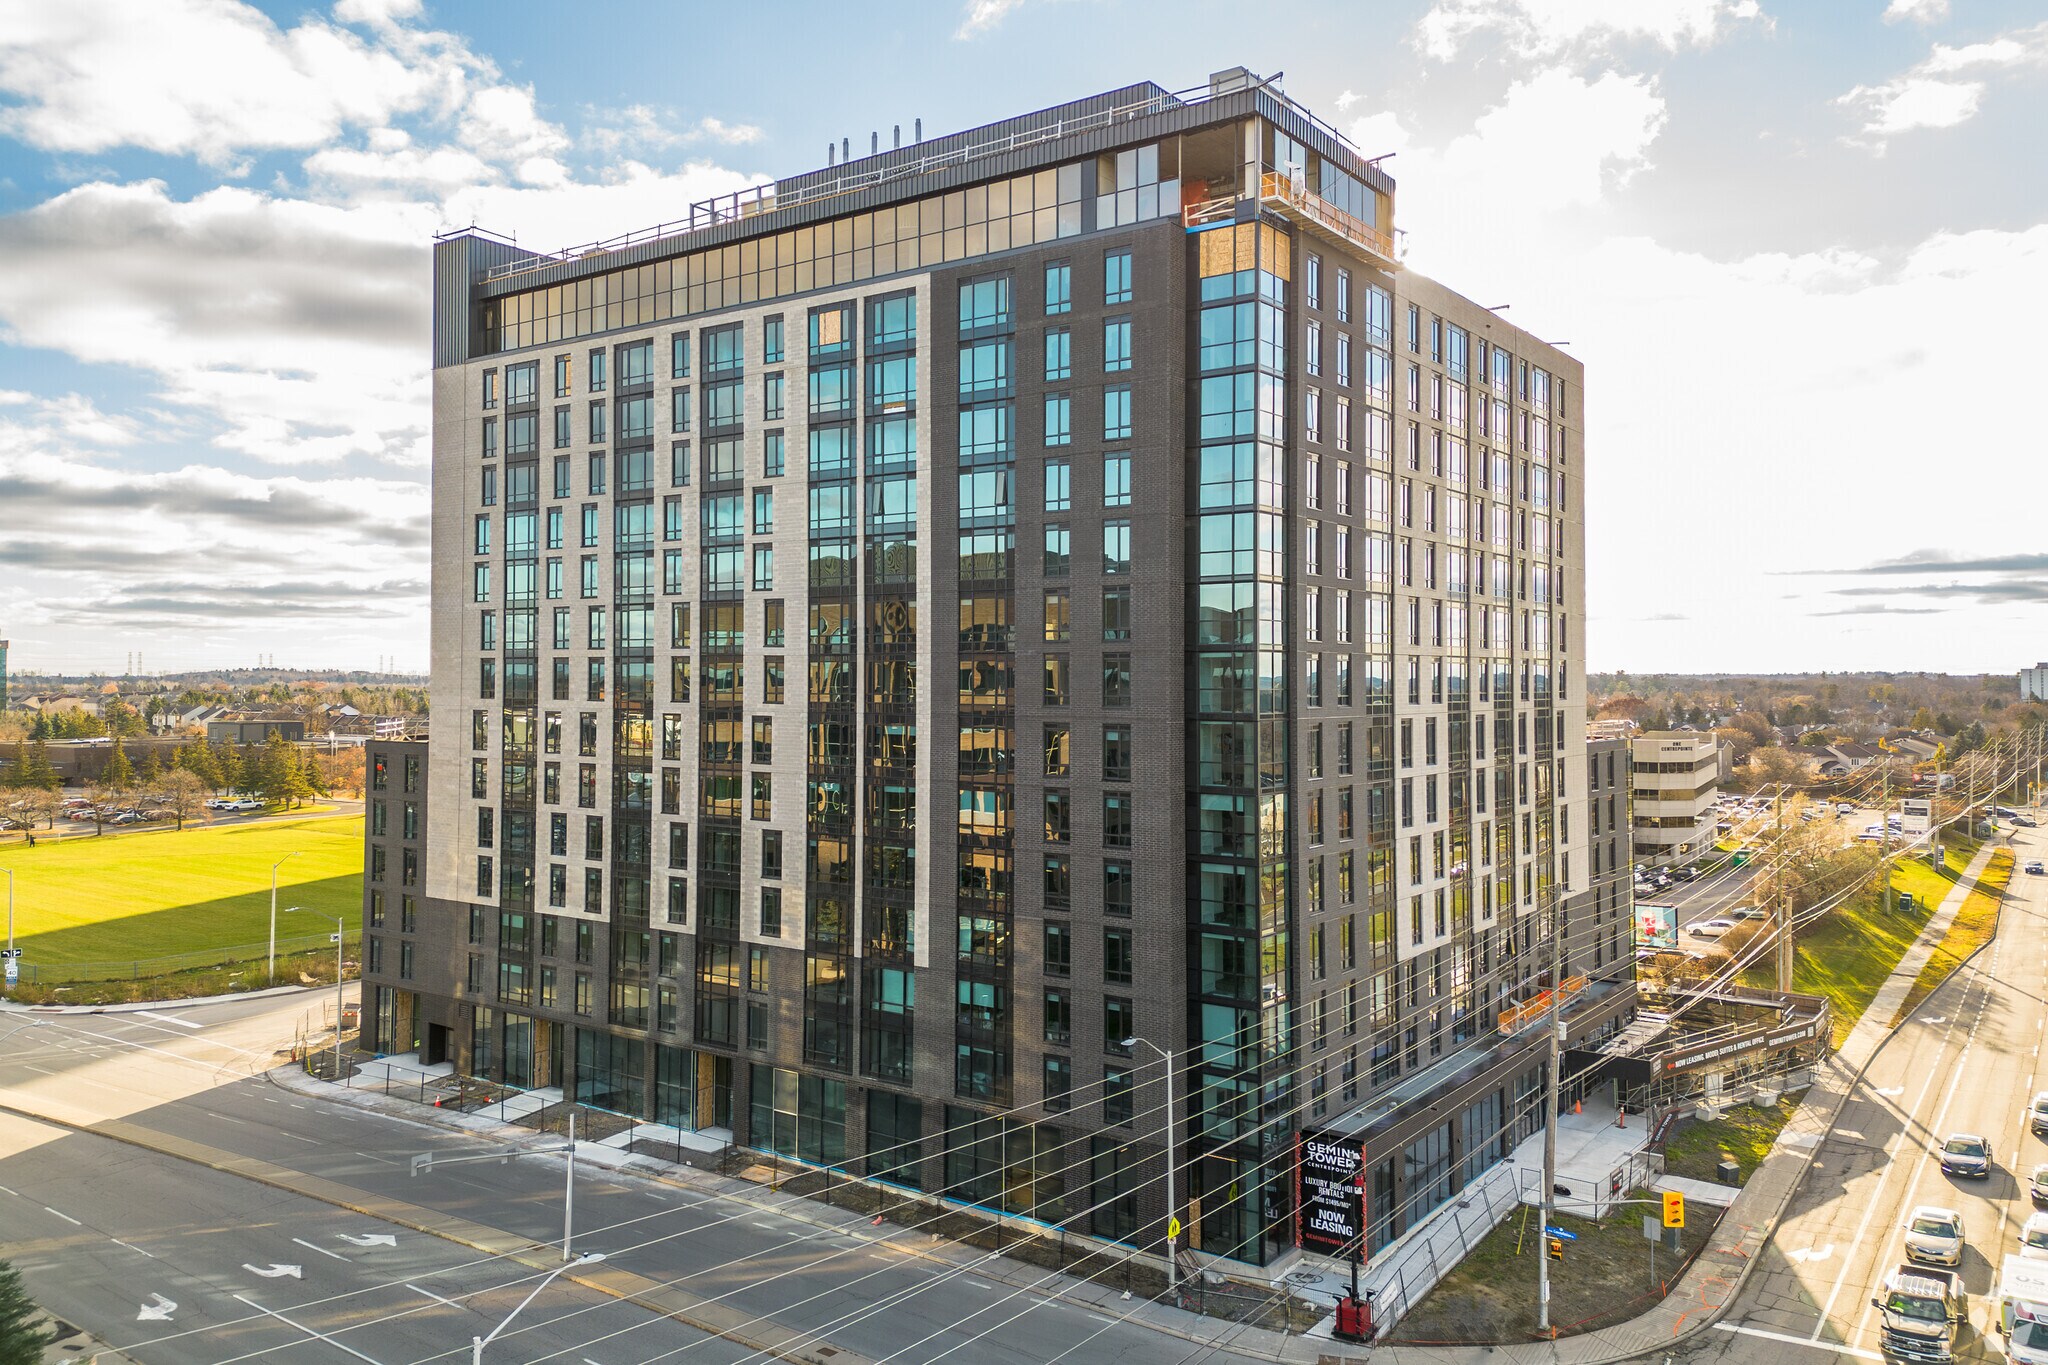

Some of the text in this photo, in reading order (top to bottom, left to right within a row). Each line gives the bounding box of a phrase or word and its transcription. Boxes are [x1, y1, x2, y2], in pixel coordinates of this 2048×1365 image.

[1307, 1141, 1353, 1159] GEMIN
[1305, 1176, 1328, 1188] LUXURY
[1318, 1186, 1345, 1199] RENTALS
[1318, 1208, 1345, 1224] NOW
[1310, 1217, 1353, 1237] LEASING
